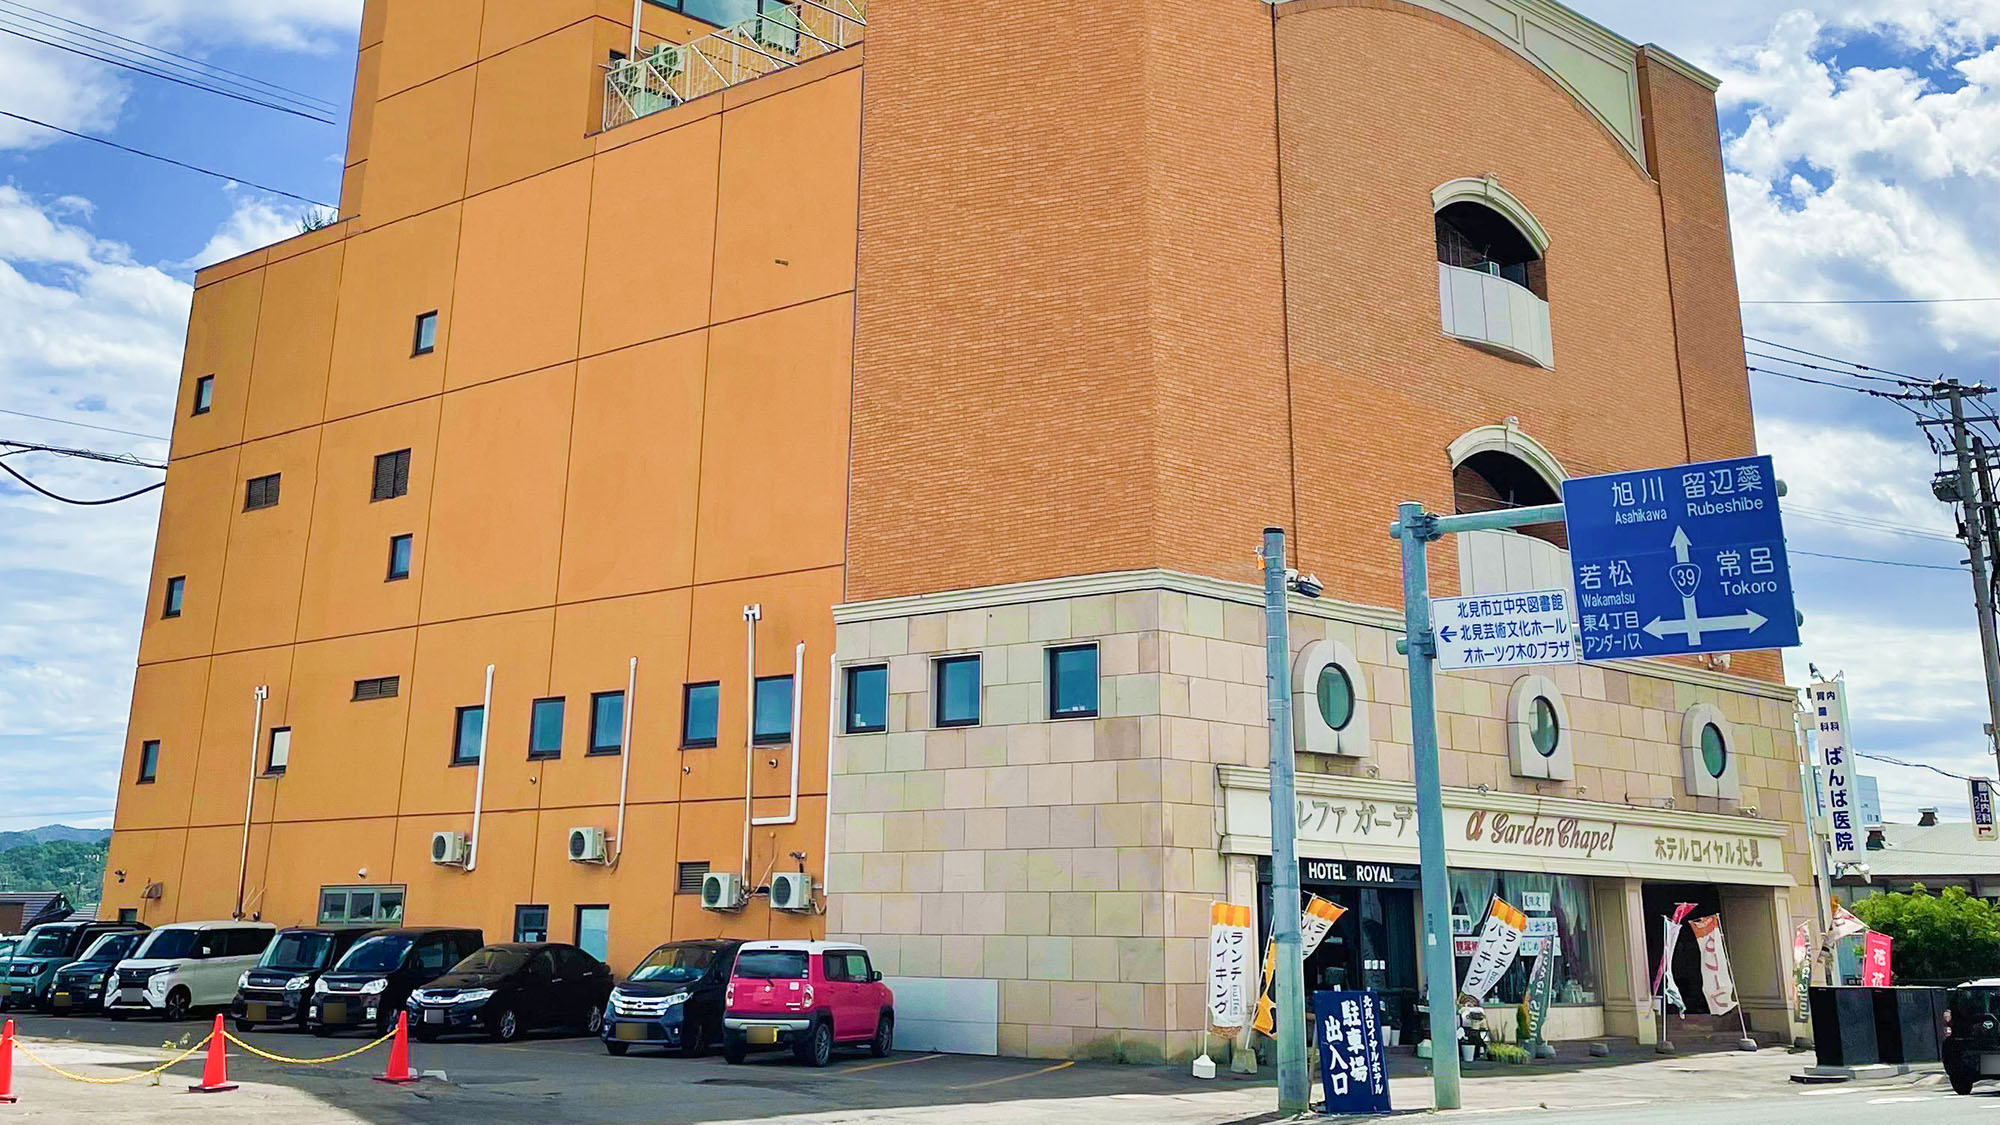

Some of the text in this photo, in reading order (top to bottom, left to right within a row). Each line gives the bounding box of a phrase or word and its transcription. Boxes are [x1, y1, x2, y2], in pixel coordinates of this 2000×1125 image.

[1611, 476, 1665, 508] 旭川
[1615, 507, 1668, 525] Asahikawa
[1687, 497, 1764, 518] Rubeshibe
[1580, 560, 1634, 590] 若松
[1716, 547, 1775, 578] 常呂
[1676, 569, 1696, 587] 39
[1720, 580, 1778, 597] Tokoro
[1457, 594, 1564, 619] 北見市立中央図書館
[1581, 591, 1636, 608] Wakamatsu
[1460, 617, 1567, 641] 北見芸術文化ホール
[1583, 611, 1640, 632] 東4丁目
[1463, 640, 1570, 664] オホーツク木のプラザ
[1584, 633, 1643, 653] アンダーパス
[1825, 746, 1854, 851] ばんば医院
[1491, 813, 1554, 848] Garden
[1557, 817, 1617, 858] Chapel
[1655, 836, 1762, 867] ホテルロイヤル北見
[1308, 862, 1394, 883] HOTEL ROYAL
[1231, 931, 1243, 981] ランチ
[1214, 930, 1228, 1014] バイキング
[1341, 1000, 1368, 1082] 駐車場
[1363, 995, 1384, 1095] 北見ロイヤルホテル
[1324, 1015, 1348, 1095] 出入口
